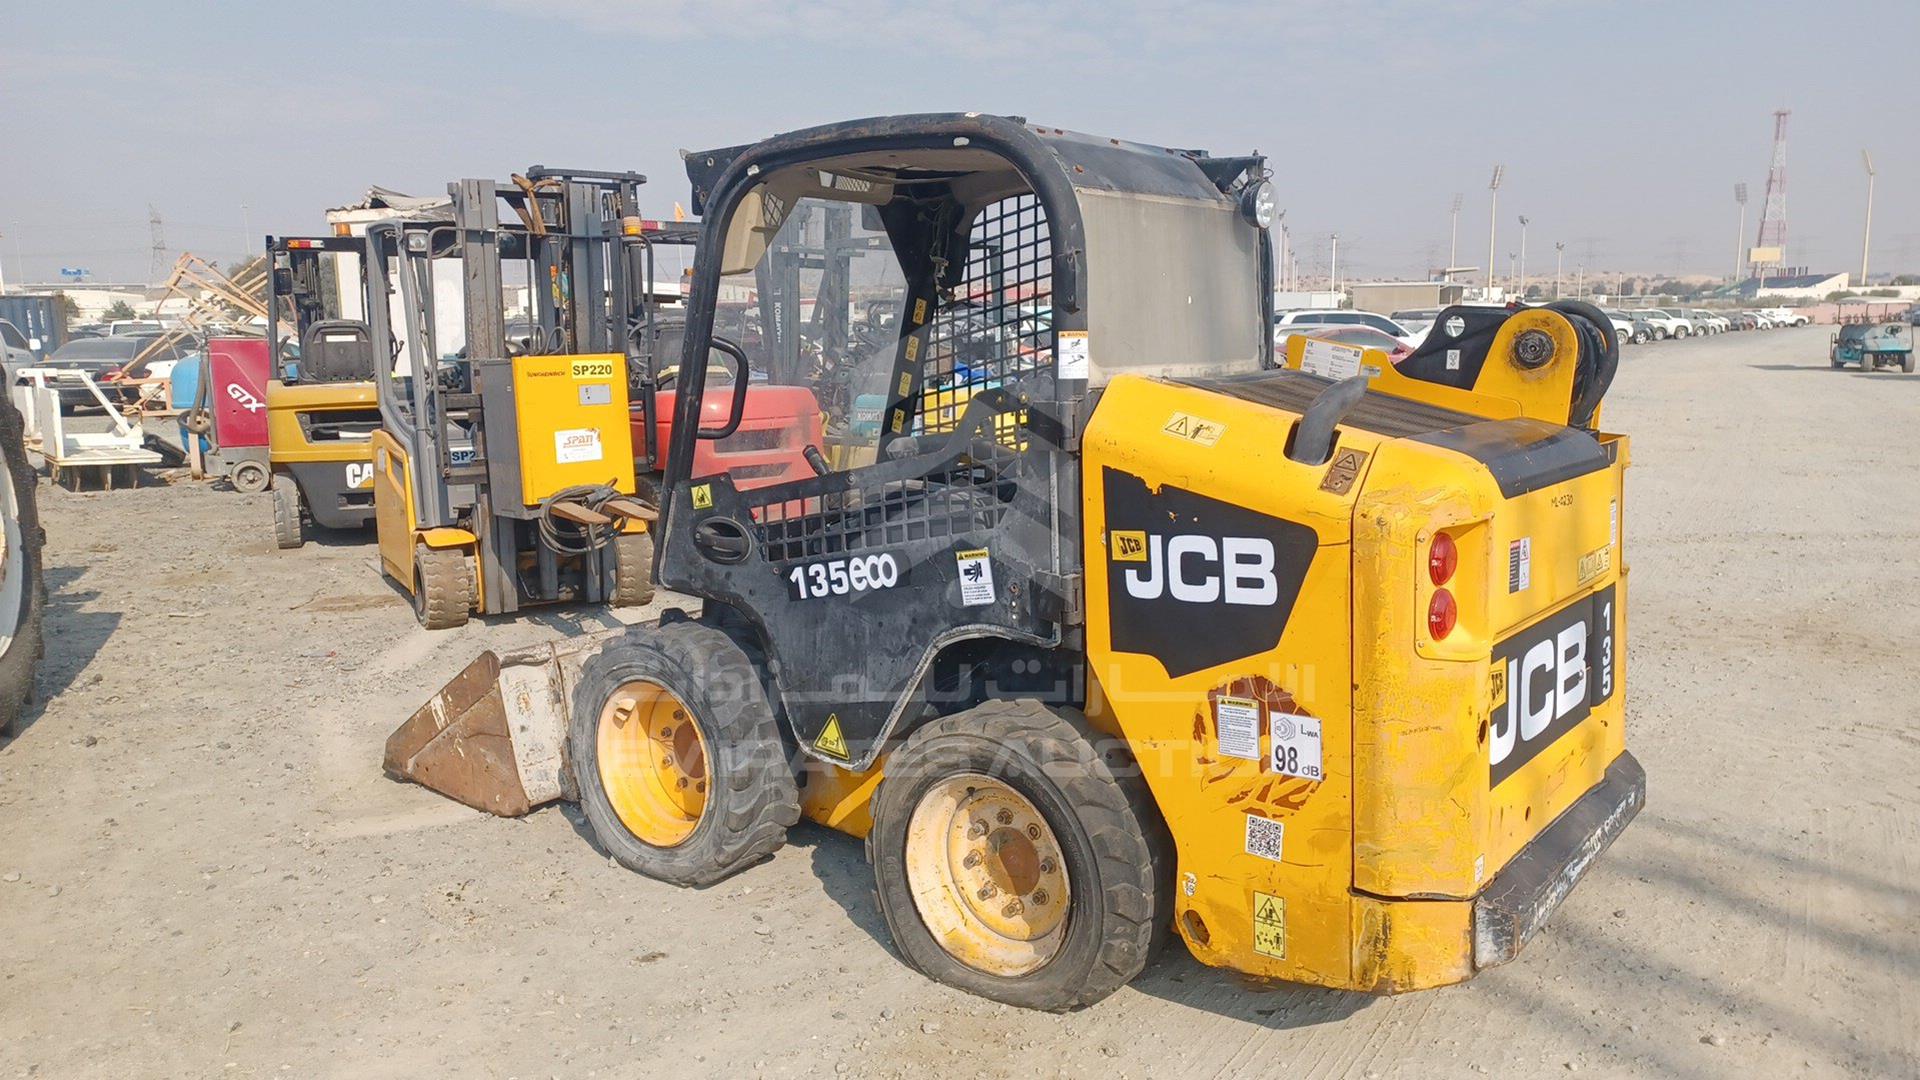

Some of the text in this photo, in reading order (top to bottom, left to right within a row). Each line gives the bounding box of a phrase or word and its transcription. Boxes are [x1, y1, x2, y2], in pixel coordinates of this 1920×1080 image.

[572, 364, 613, 376] SP220
[227, 383, 266, 413] GTX
[345, 462, 374, 489] CA
[1120, 537, 1142, 555] JCB
[789, 552, 898, 599] 135eco
[1125, 534, 1278, 606] JCB
[1490, 620, 1587, 766] JCB
[1275, 744, 1320, 778] 98 dB
